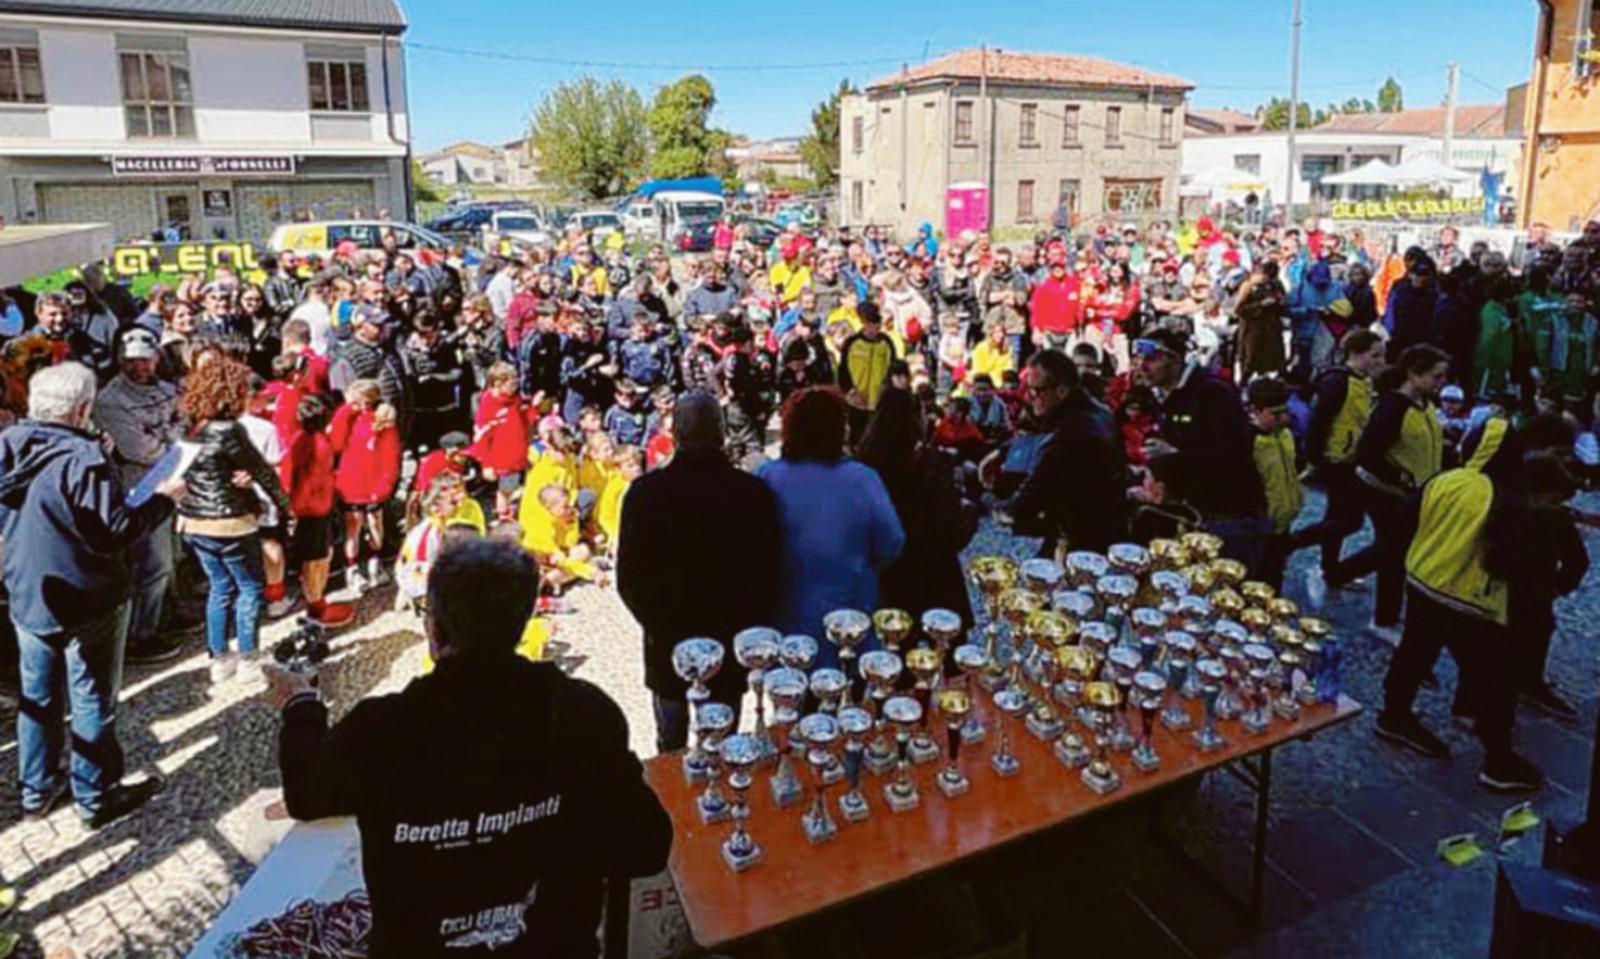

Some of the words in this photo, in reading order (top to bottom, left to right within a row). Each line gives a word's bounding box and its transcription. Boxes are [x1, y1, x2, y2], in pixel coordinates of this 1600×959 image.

[115, 159, 198, 169] MACELLERIA
[394, 817, 469, 843] Beretta
[476, 794, 561, 834] Impianti
